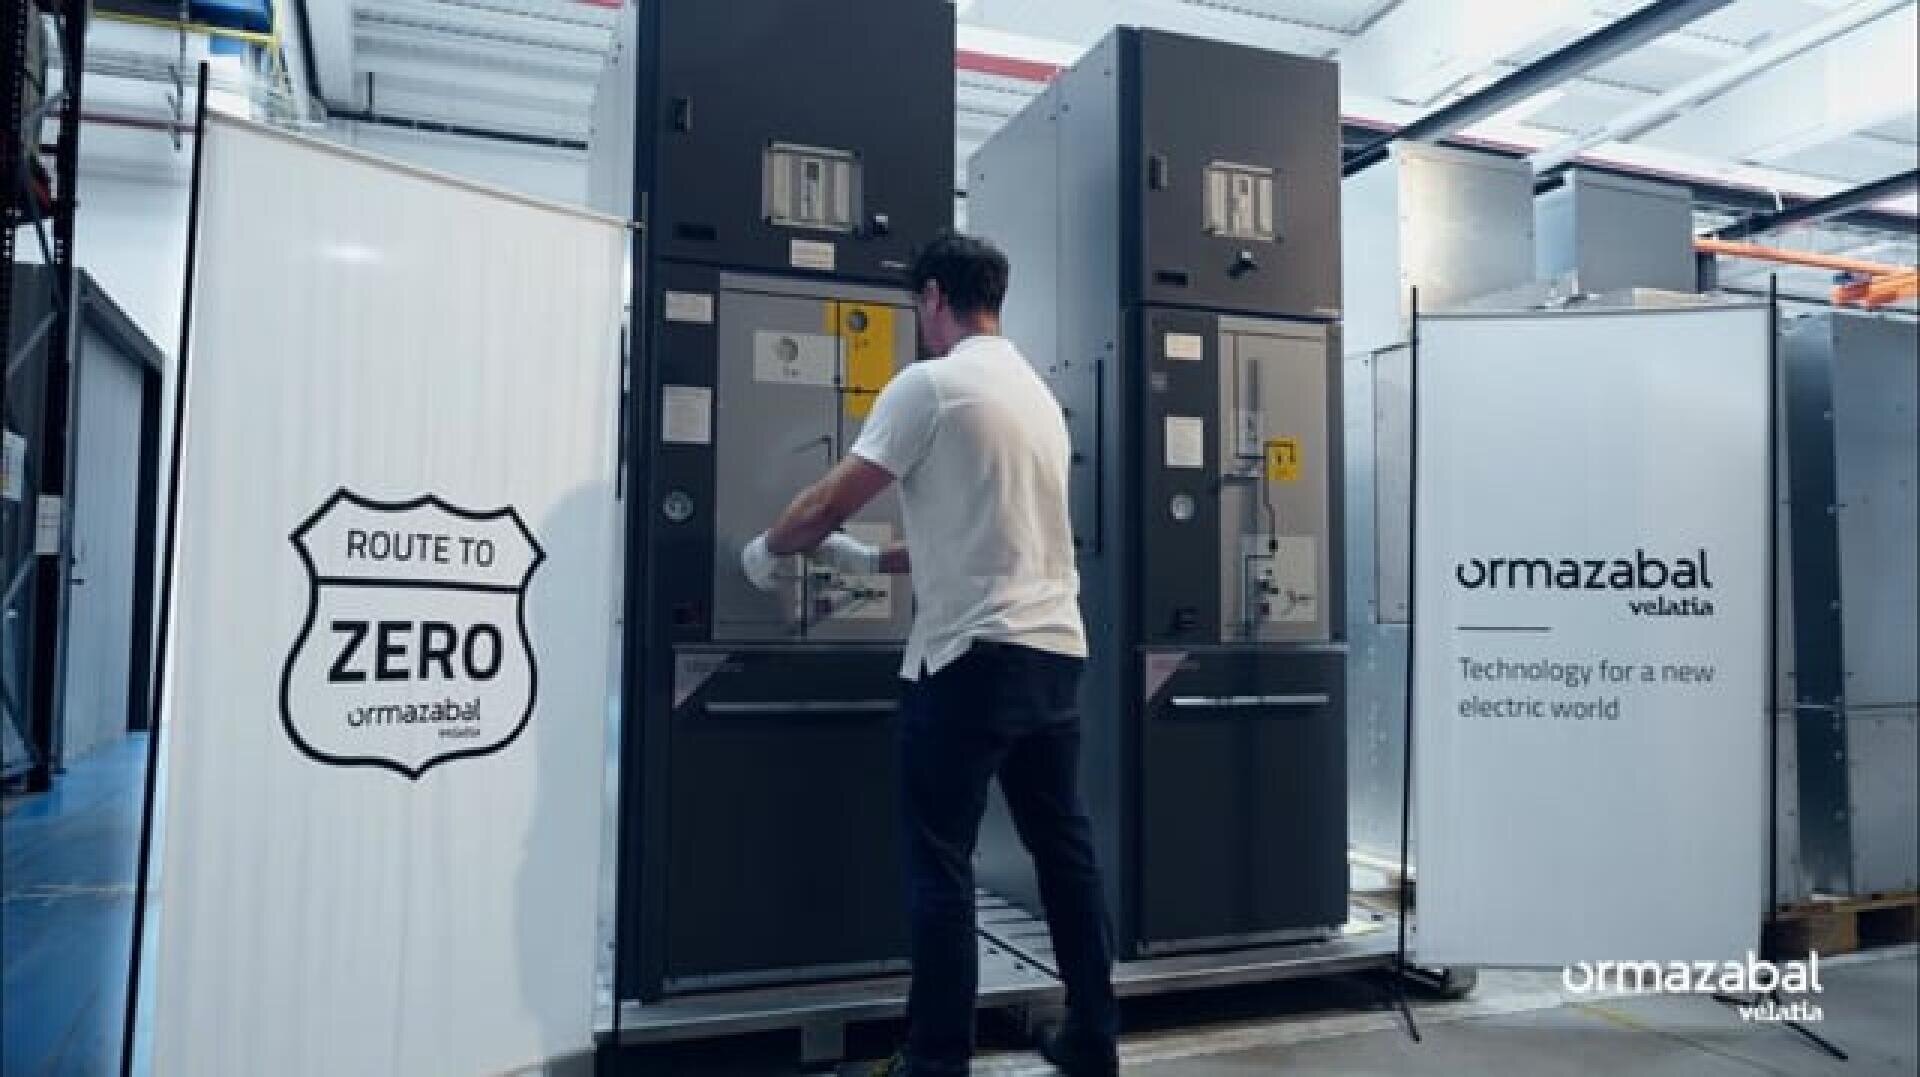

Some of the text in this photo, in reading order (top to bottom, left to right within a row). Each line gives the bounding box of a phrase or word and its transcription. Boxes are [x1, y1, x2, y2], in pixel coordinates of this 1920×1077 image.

[348, 530, 495, 567] ROUTE TO
[1456, 548, 1714, 589] ormazabal
[328, 620, 503, 682] ZERO
[1458, 656, 1716, 688] Technology for a new
[347, 697, 481, 727] ormazabal
[1458, 695, 1621, 720] electric world
